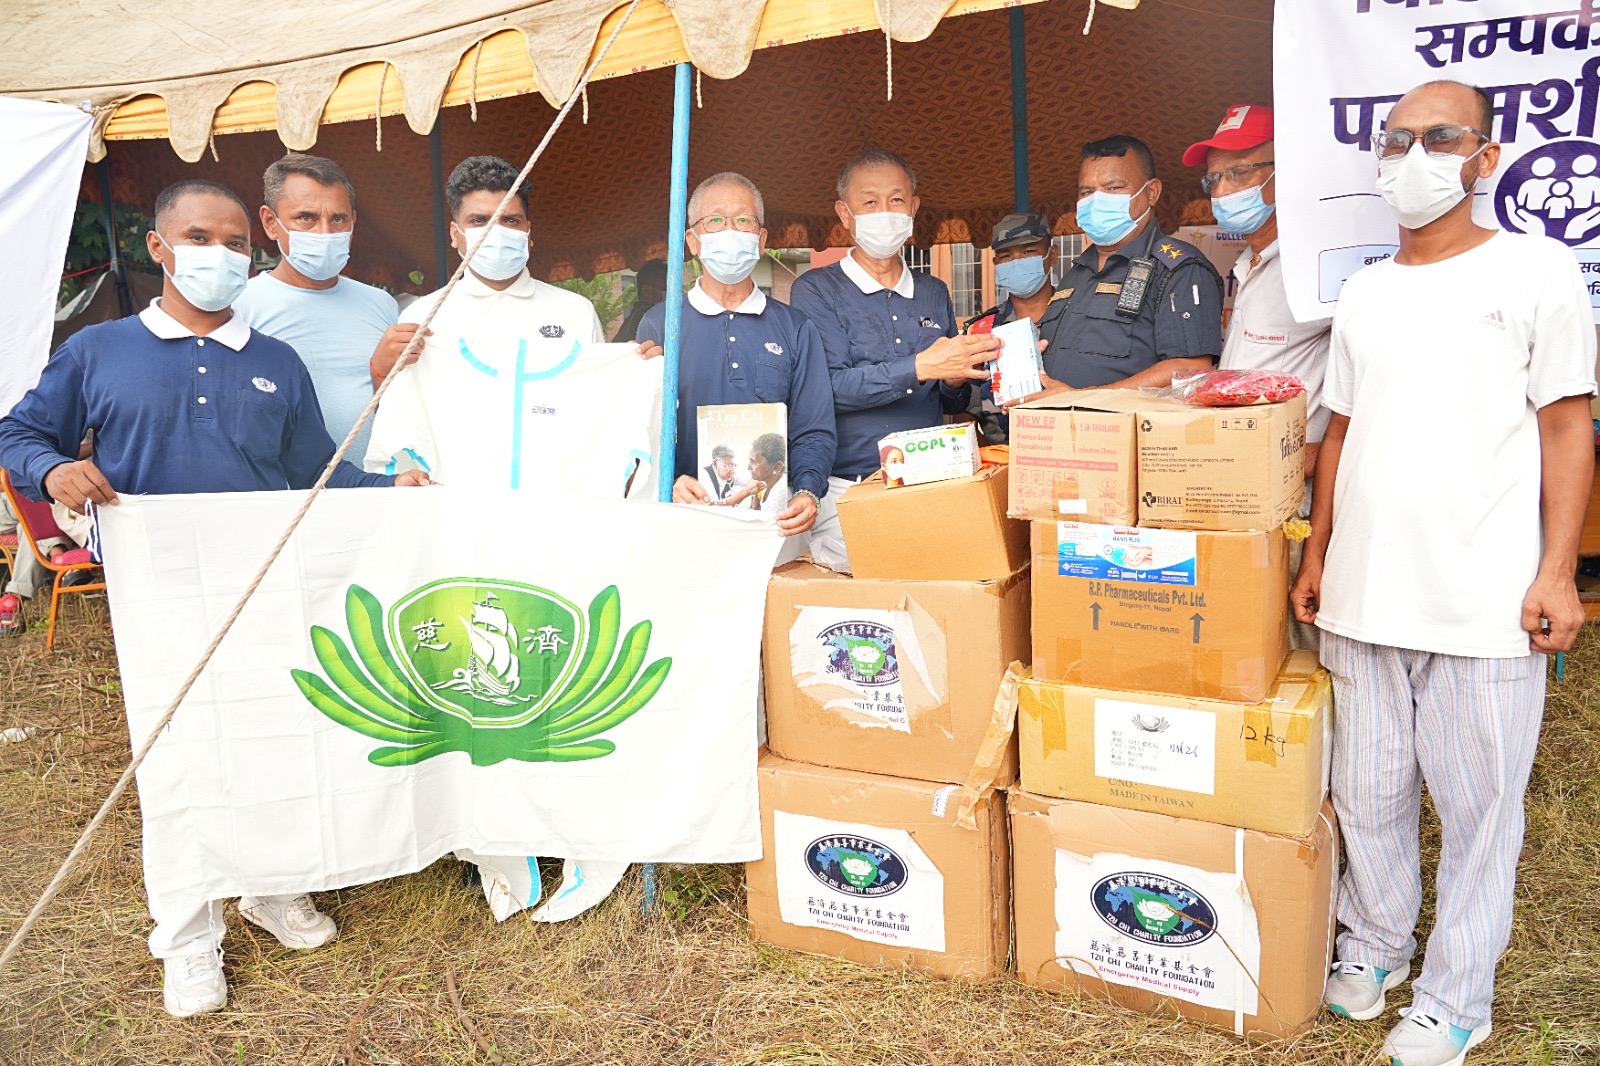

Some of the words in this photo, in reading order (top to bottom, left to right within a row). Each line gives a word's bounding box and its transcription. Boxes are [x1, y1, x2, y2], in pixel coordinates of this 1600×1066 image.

[1016, 415, 1039, 427] NEW
[1092, 424, 1120, 433] THAILAND
[1089, 582, 1102, 596] R.P.
[1104, 583, 1170, 604] Pharmaceuticals
[1172, 590, 1188, 606] Pvt.
[1190, 592, 1206, 608] Ltd.
[1154, 603, 1172, 612] Nepal
[1110, 620, 1140, 630] HANDLE
[1140, 622, 1158, 632] WITH
[522, 624, 569, 655] 濟
[1240, 725, 1258, 740] 12
[1110, 788, 1138, 800] MADE
[1140, 794, 1150, 802] IN
[1152, 795, 1194, 808] TAIWAN
[840, 884, 863, 894] CHARITY
[808, 908, 820, 916] TZU
[822, 910, 834, 918] CHI
[836, 913, 864, 924] CHARITY
[868, 918, 910, 932] FOUNDATION
[1106, 912, 1118, 924] TZU
[1118, 922, 1130, 932] CHI
[1132, 928, 1161, 942] CHARITY
[1164, 929, 1204, 942] FOUNDATION
[1090, 952, 1104, 962] TZU
[1108, 955, 1121, 966] CHI
[1125, 960, 1159, 976] CHARITY
[1163, 970, 1215, 989] FOUNDATION
[1099, 965, 1140, 982] Emergency
[1142, 976, 1171, 989] Medical
[1173, 984, 1200, 996] Supply
